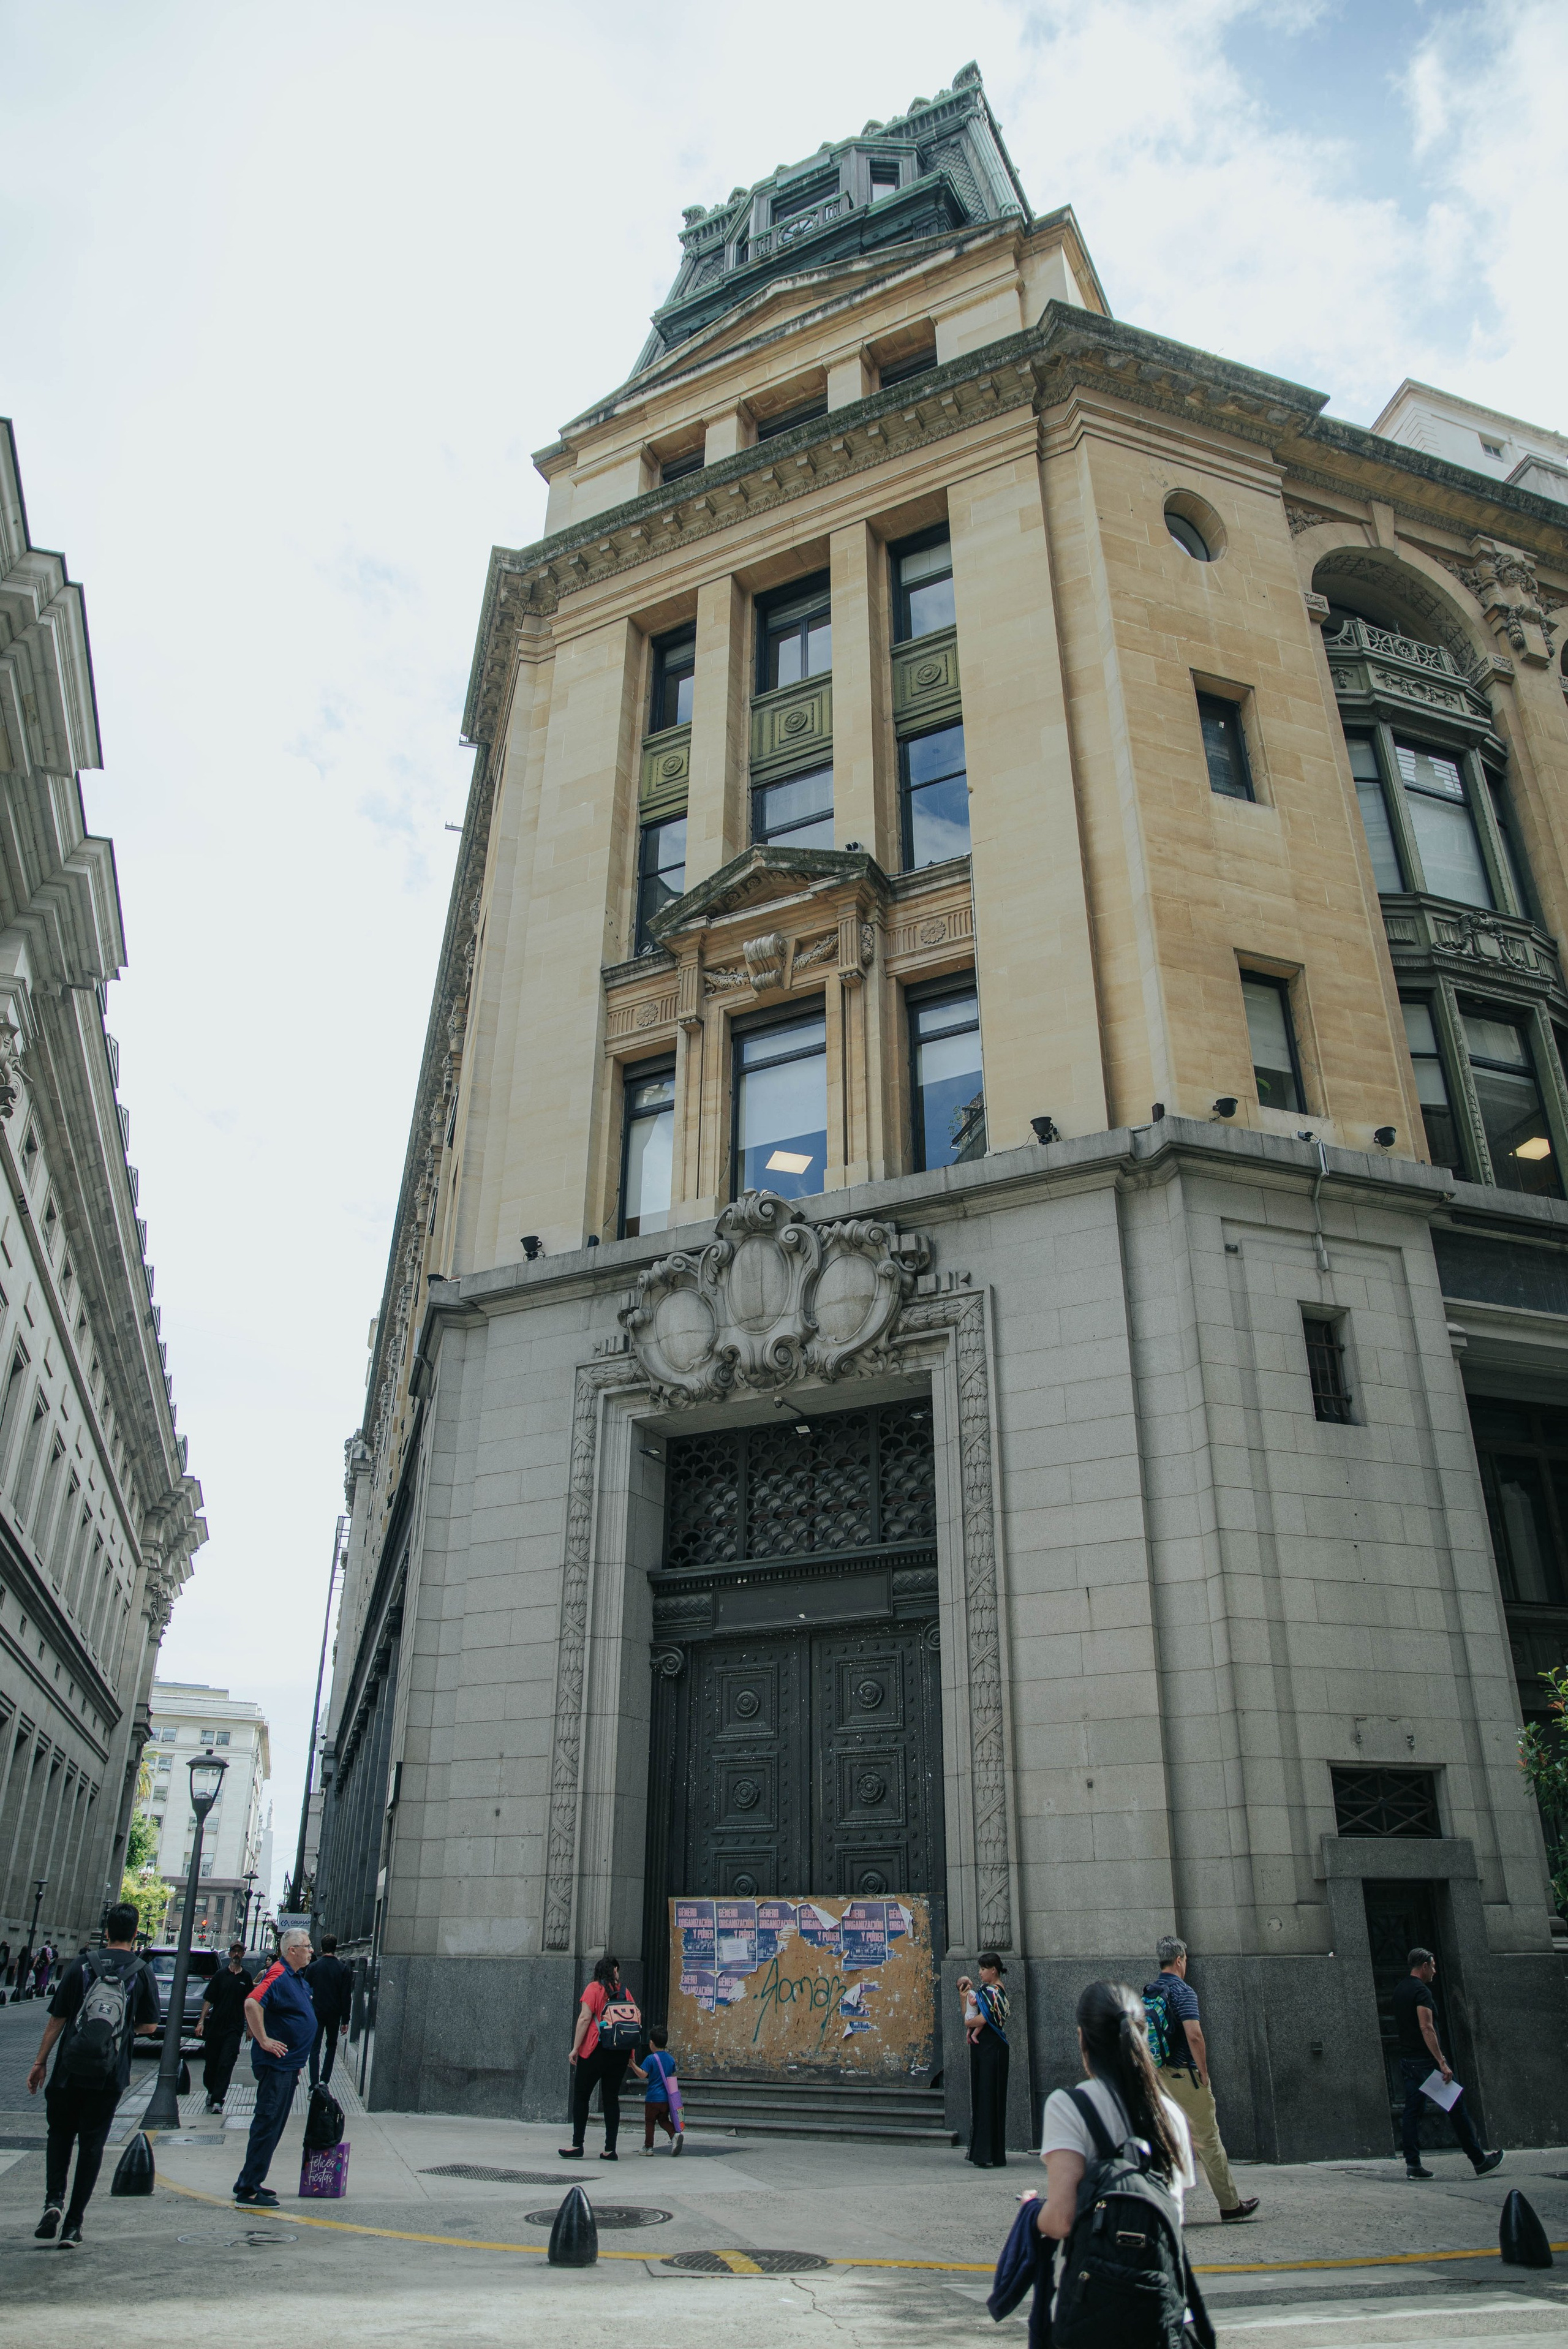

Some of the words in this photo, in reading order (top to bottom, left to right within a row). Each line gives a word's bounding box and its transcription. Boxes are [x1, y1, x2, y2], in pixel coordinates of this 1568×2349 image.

[678, 1906, 697, 1917] GÉNERO
[718, 1907, 738, 1918] GÉNERO
[760, 1907, 779, 1918] GÉNERO
[678, 1917, 713, 1928] ORGANIZACIÓN
[718, 1917, 755, 1929] ORGANIZACIÓN
[845, 1918, 884, 1930] ORGANIZACIÓN
[697, 1929, 714, 1939] PODER
[822, 1931, 840, 1942] PODER
[866, 1932, 884, 1942] PODER
[310, 2154, 336, 2171] Felices
[308, 2168, 334, 2188] Fiestas
